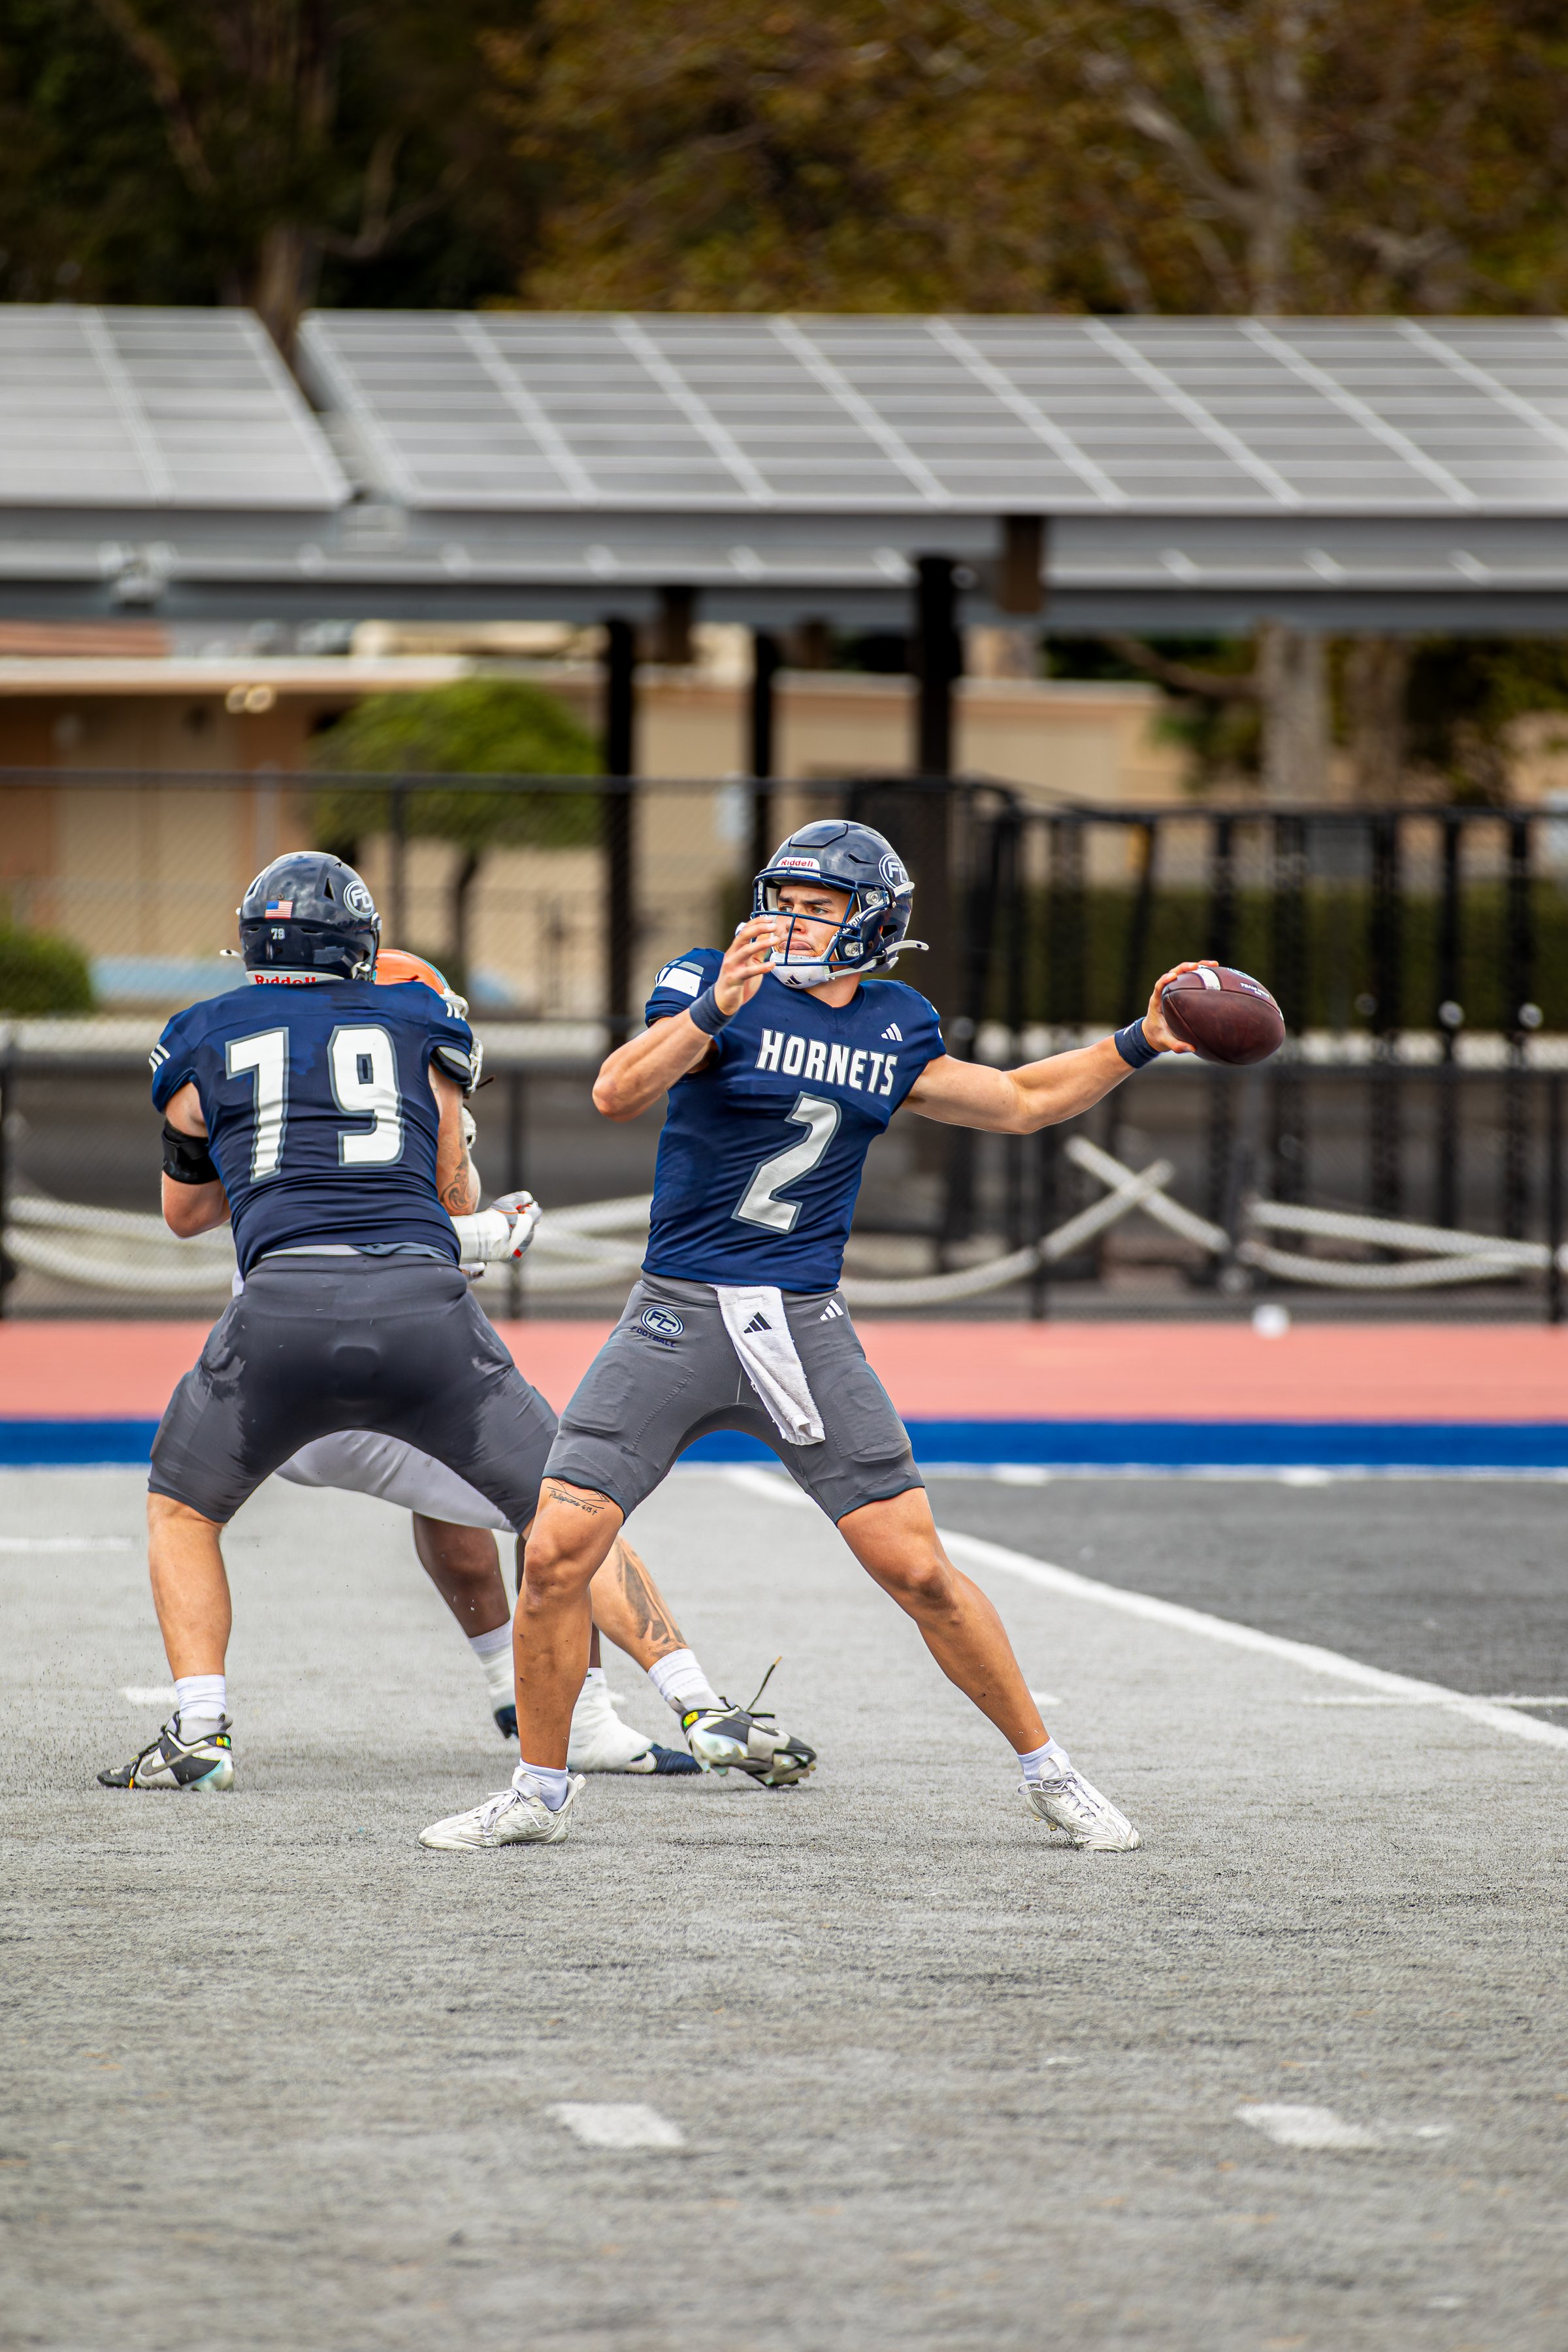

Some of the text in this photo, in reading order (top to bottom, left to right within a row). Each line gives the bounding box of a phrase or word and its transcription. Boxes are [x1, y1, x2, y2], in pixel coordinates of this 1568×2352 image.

[755, 1028, 898, 1096] HORNETS
[225, 1023, 405, 1184] 79
[730, 1090, 842, 1235] 2
[630, 1325, 676, 1348] FOOTBALL
[647, 1310, 677, 1333] FC
